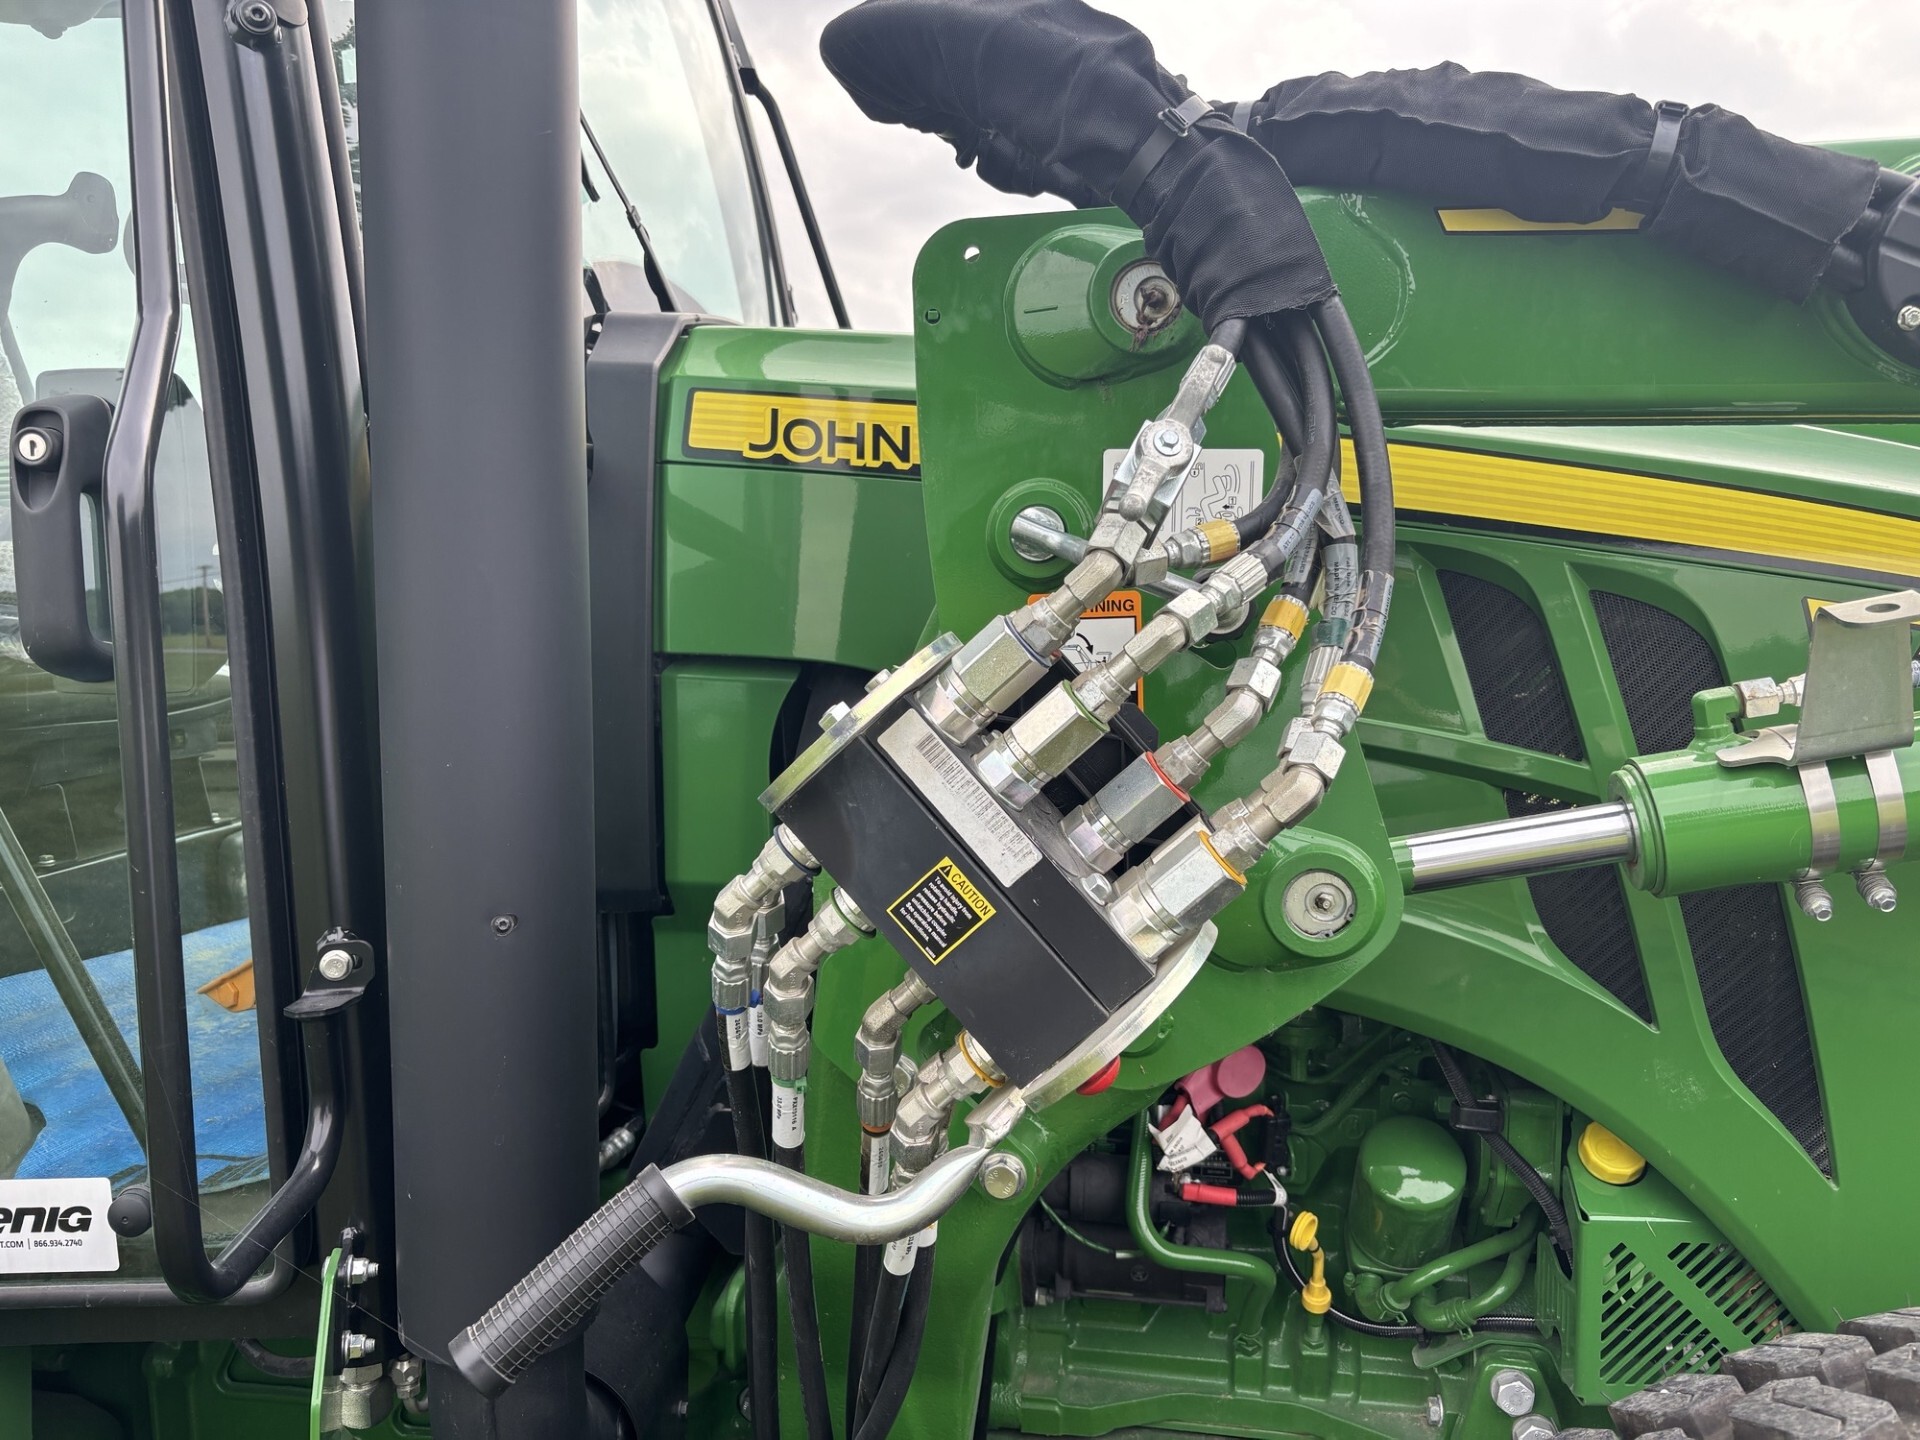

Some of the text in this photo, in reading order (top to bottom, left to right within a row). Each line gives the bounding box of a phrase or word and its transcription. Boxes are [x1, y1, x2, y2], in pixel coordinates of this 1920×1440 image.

[748, 407, 911, 464] JOHN
[951, 873, 991, 917] CAUTION
[33, 1238, 83, 1248] 866.934.2740
